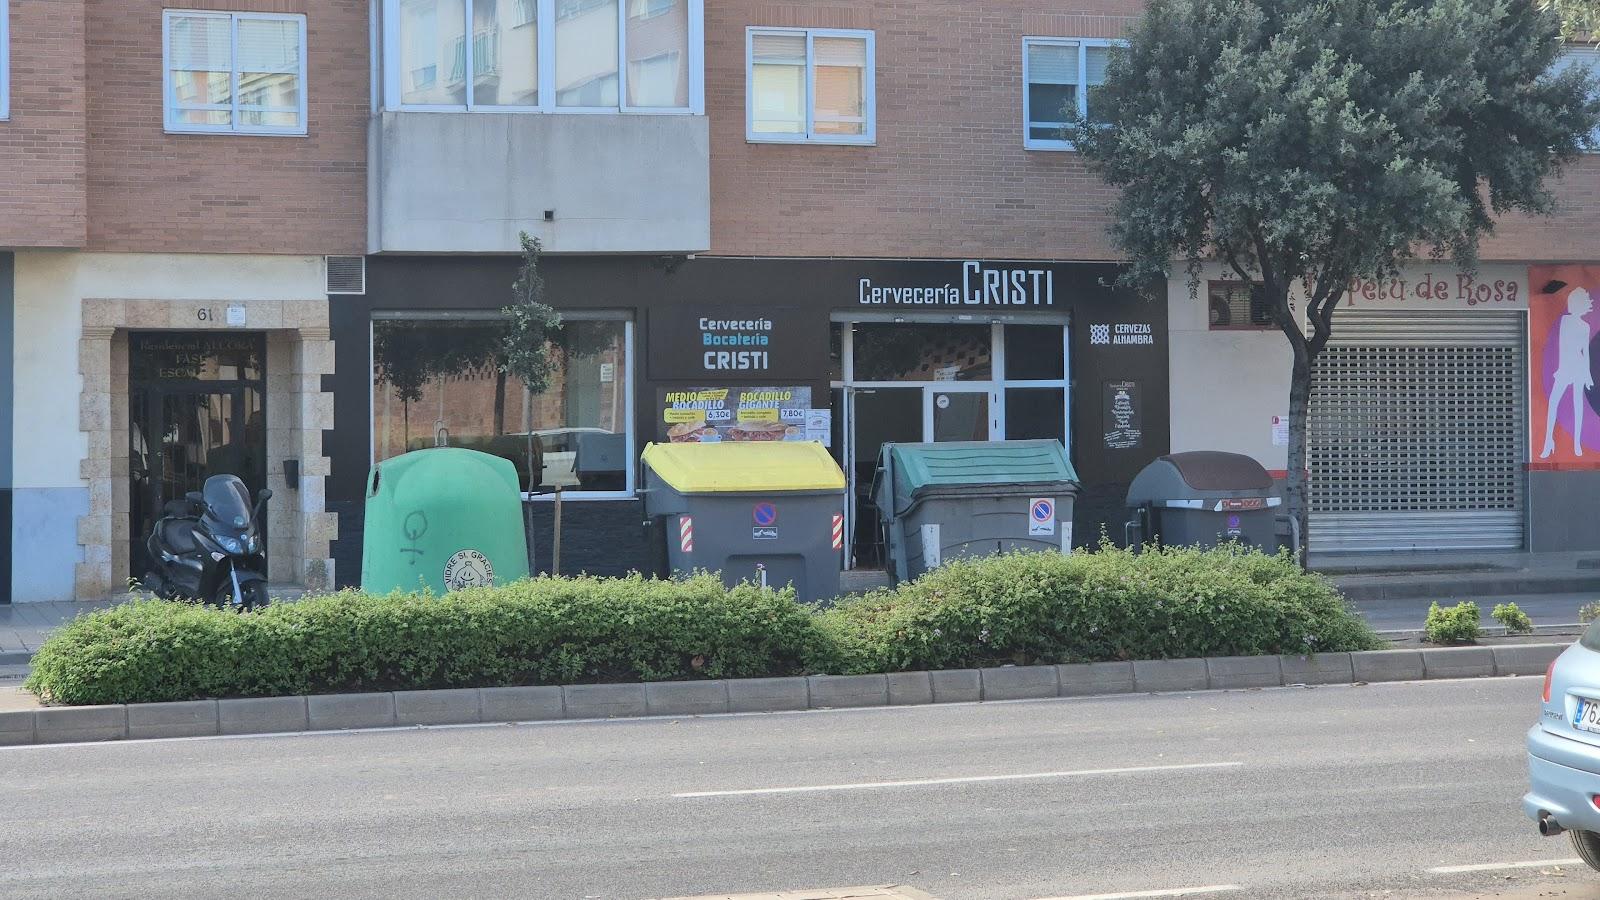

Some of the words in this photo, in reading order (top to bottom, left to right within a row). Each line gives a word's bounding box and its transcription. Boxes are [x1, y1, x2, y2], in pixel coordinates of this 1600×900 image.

[859, 278, 960, 305] Cervecería
[963, 261, 1053, 305] CRISTI
[1415, 273, 1449, 301] de
[1455, 273, 1519, 306] Rosa
[197, 308, 213, 321] 61
[699, 317, 772, 330] Cervecería
[1114, 323, 1151, 334] CERVEZAS
[703, 333, 769, 346] Bocatería
[1113, 335, 1153, 345] ALHAMBRA
[703, 351, 768, 370] CRISTI
[665, 392, 700, 403] MEDIO
[739, 391, 792, 401] BOCADILLO
[672, 400, 725, 410] BOCADILLO
[738, 400, 780, 409] GIGANTE
[445, 558, 457, 584] VIDRE
[471, 551, 493, 584] GRACIES
